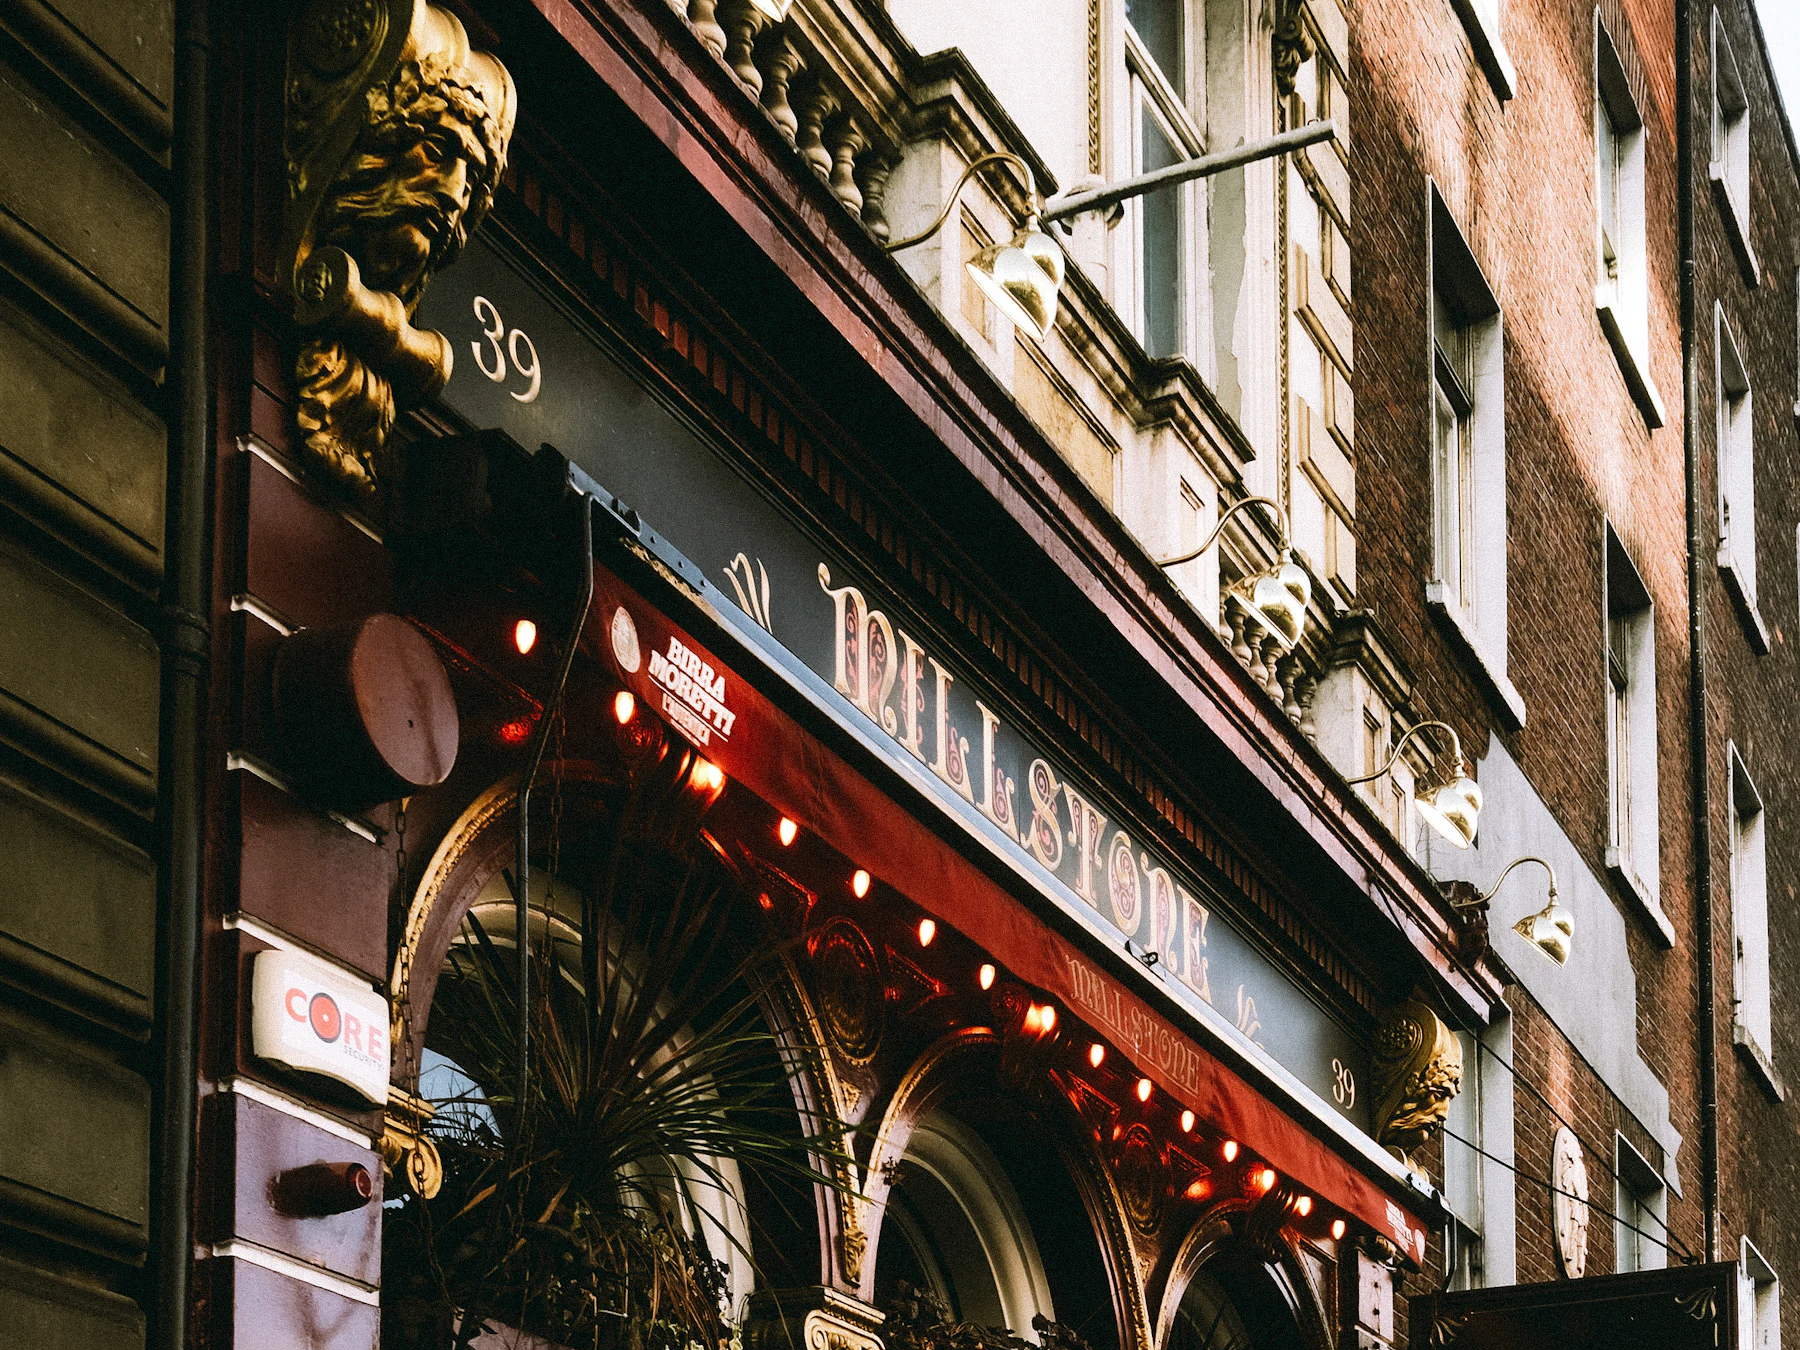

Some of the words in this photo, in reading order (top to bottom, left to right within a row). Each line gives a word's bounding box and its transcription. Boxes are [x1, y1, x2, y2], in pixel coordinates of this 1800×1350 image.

[471, 296, 541, 403] 39
[648, 649, 737, 736] MORETTI
[666, 635, 726, 704] BIRRA
[818, 562, 1212, 1004] MILLSTONE
[285, 987, 382, 1062] CORE
[1066, 955, 1200, 1092] MILLSTONE
[1332, 1058, 1355, 1109] 39
